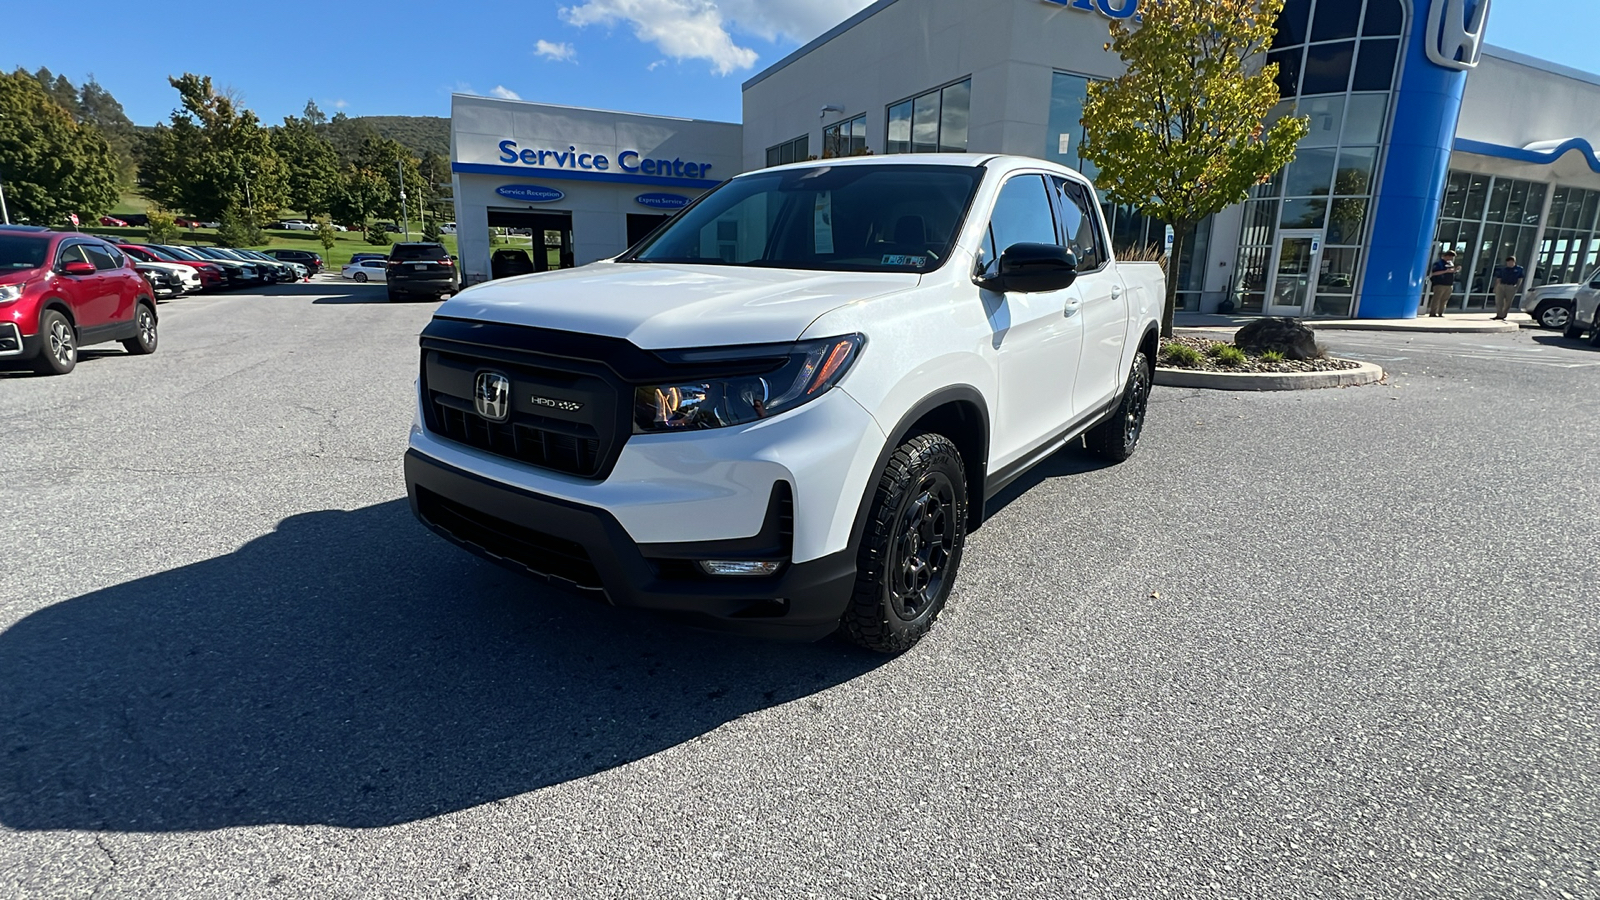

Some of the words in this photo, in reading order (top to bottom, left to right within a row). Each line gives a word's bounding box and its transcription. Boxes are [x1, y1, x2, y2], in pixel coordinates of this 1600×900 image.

[498, 139, 609, 170] Service
[617, 150, 713, 178] Center
[499, 187, 526, 196] Service
[526, 189, 560, 198] Reception
[638, 196, 661, 204] Express
[531, 395, 556, 407] HPD
